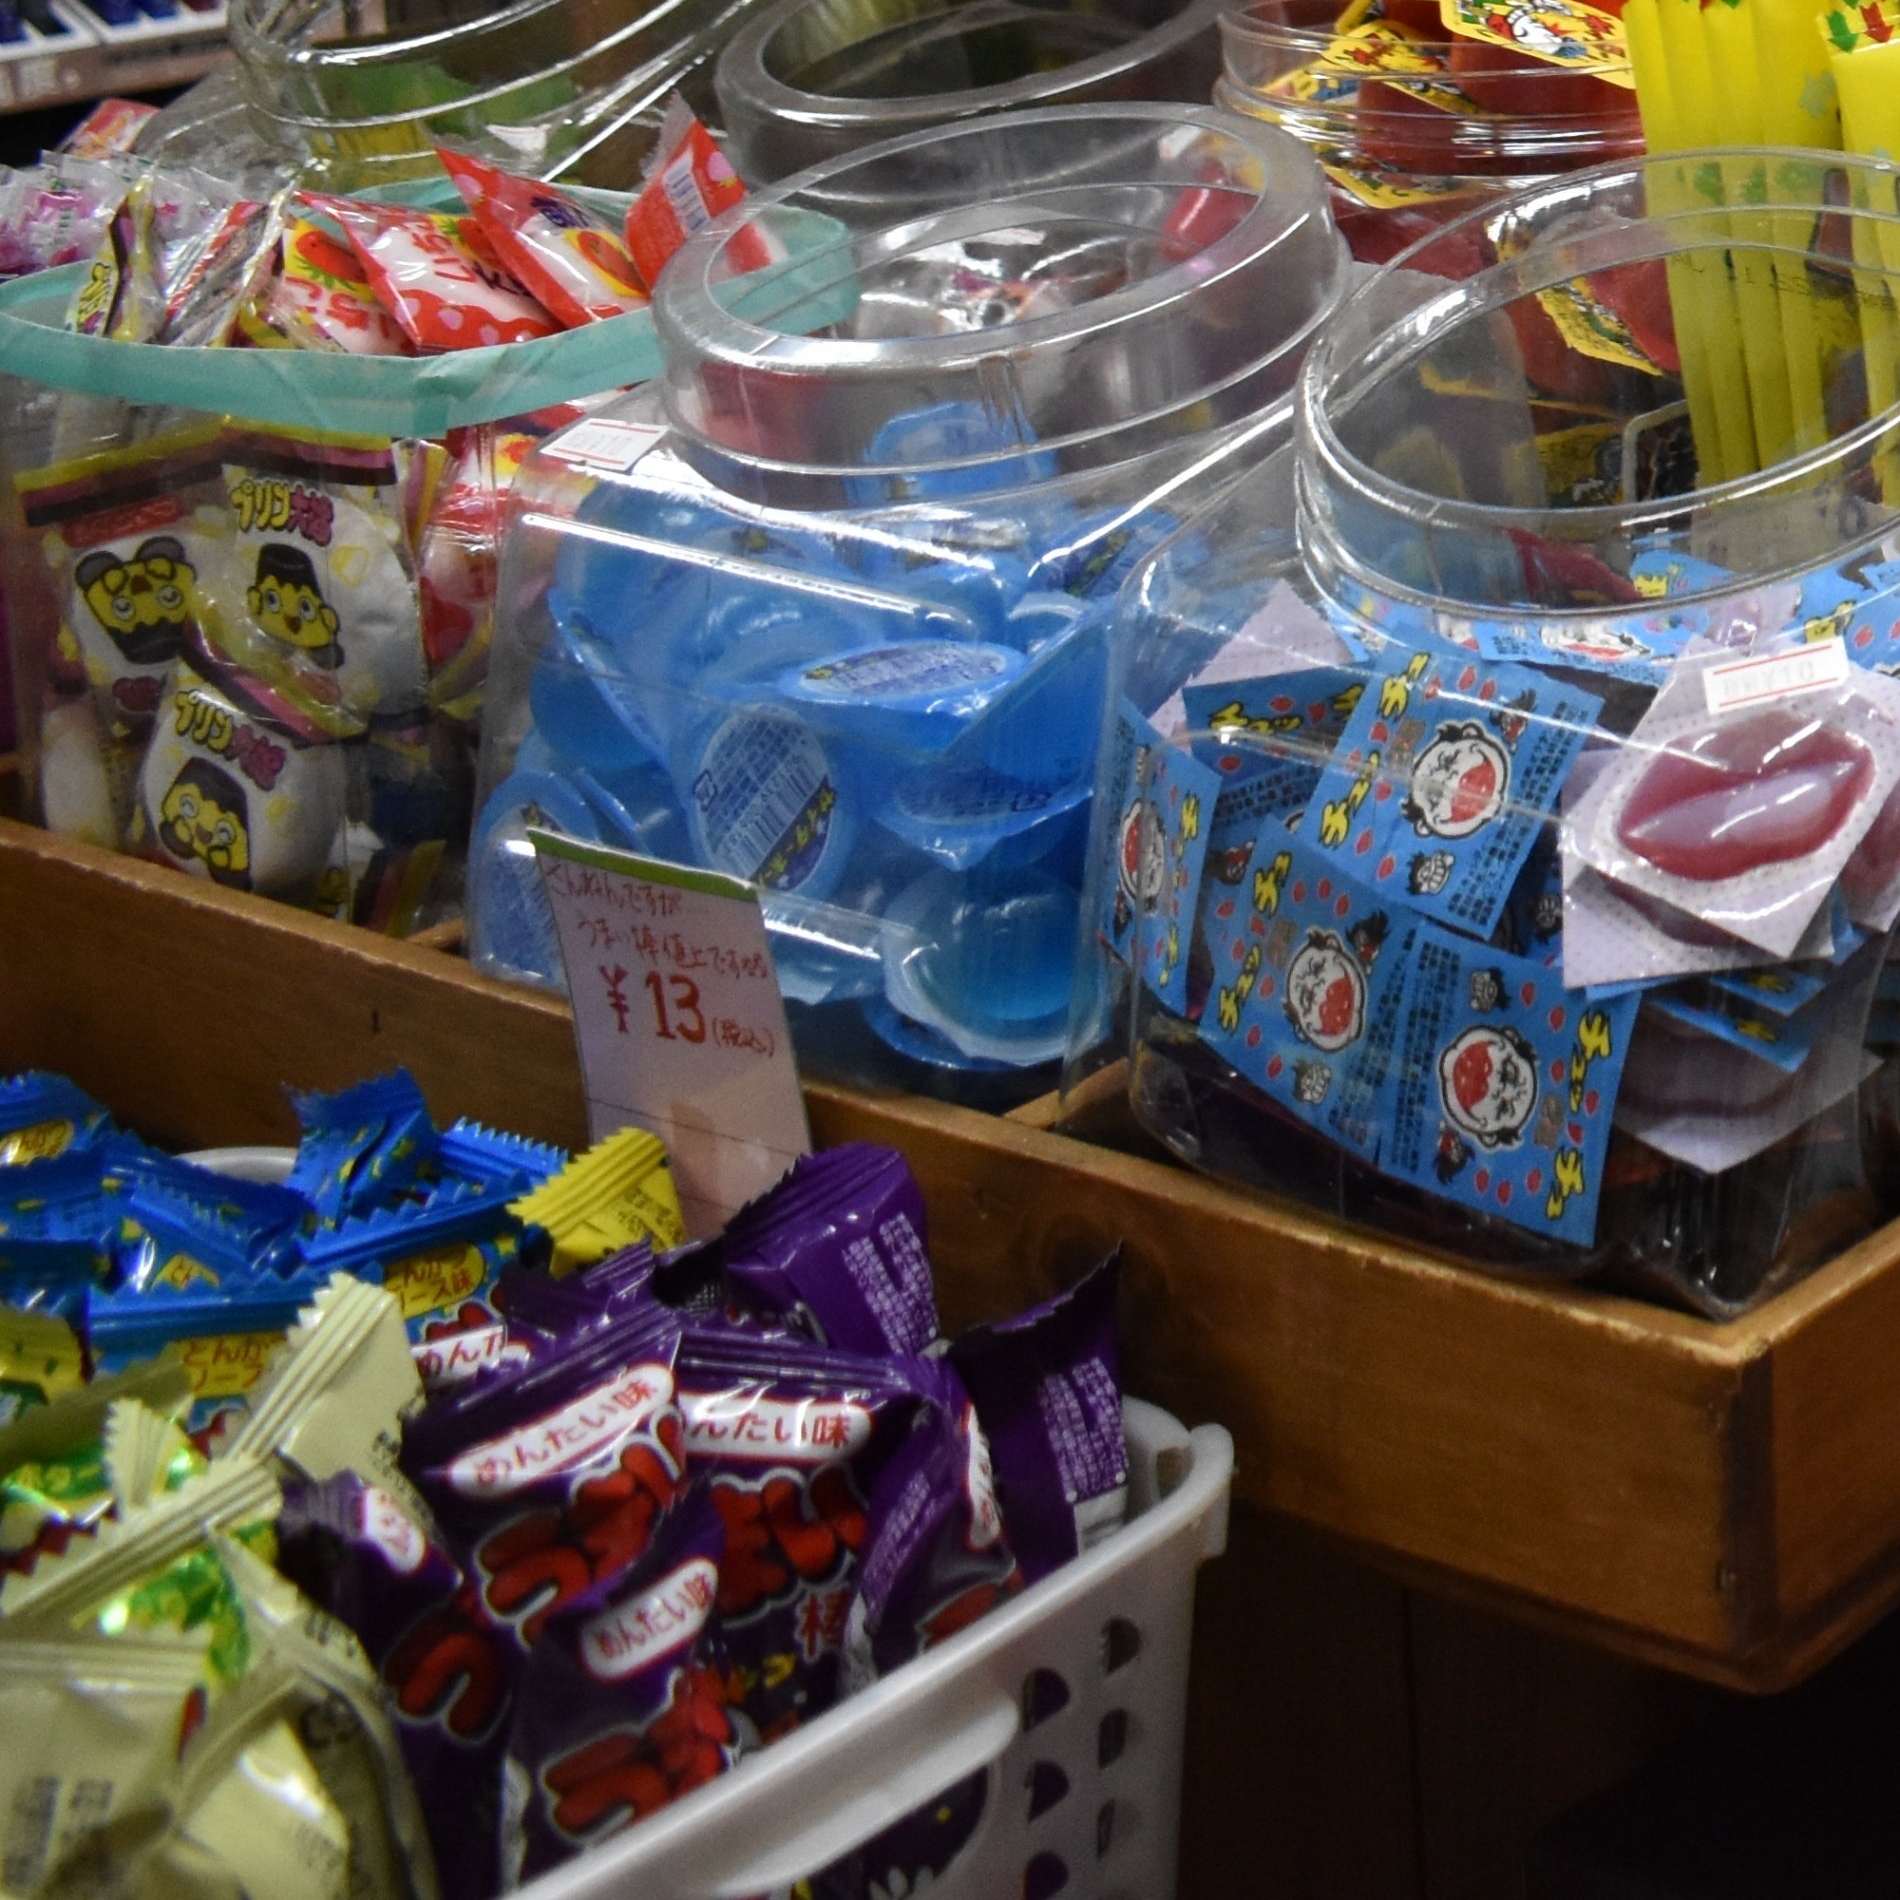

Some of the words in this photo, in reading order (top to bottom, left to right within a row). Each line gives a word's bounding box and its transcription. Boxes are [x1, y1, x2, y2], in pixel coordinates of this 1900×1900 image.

[598, 963, 707, 1045] ¥13
[471, 1380, 656, 1489] めんたい味
[695, 1415, 851, 1453] んたい味
[596, 1569, 713, 1662] めんたい味
